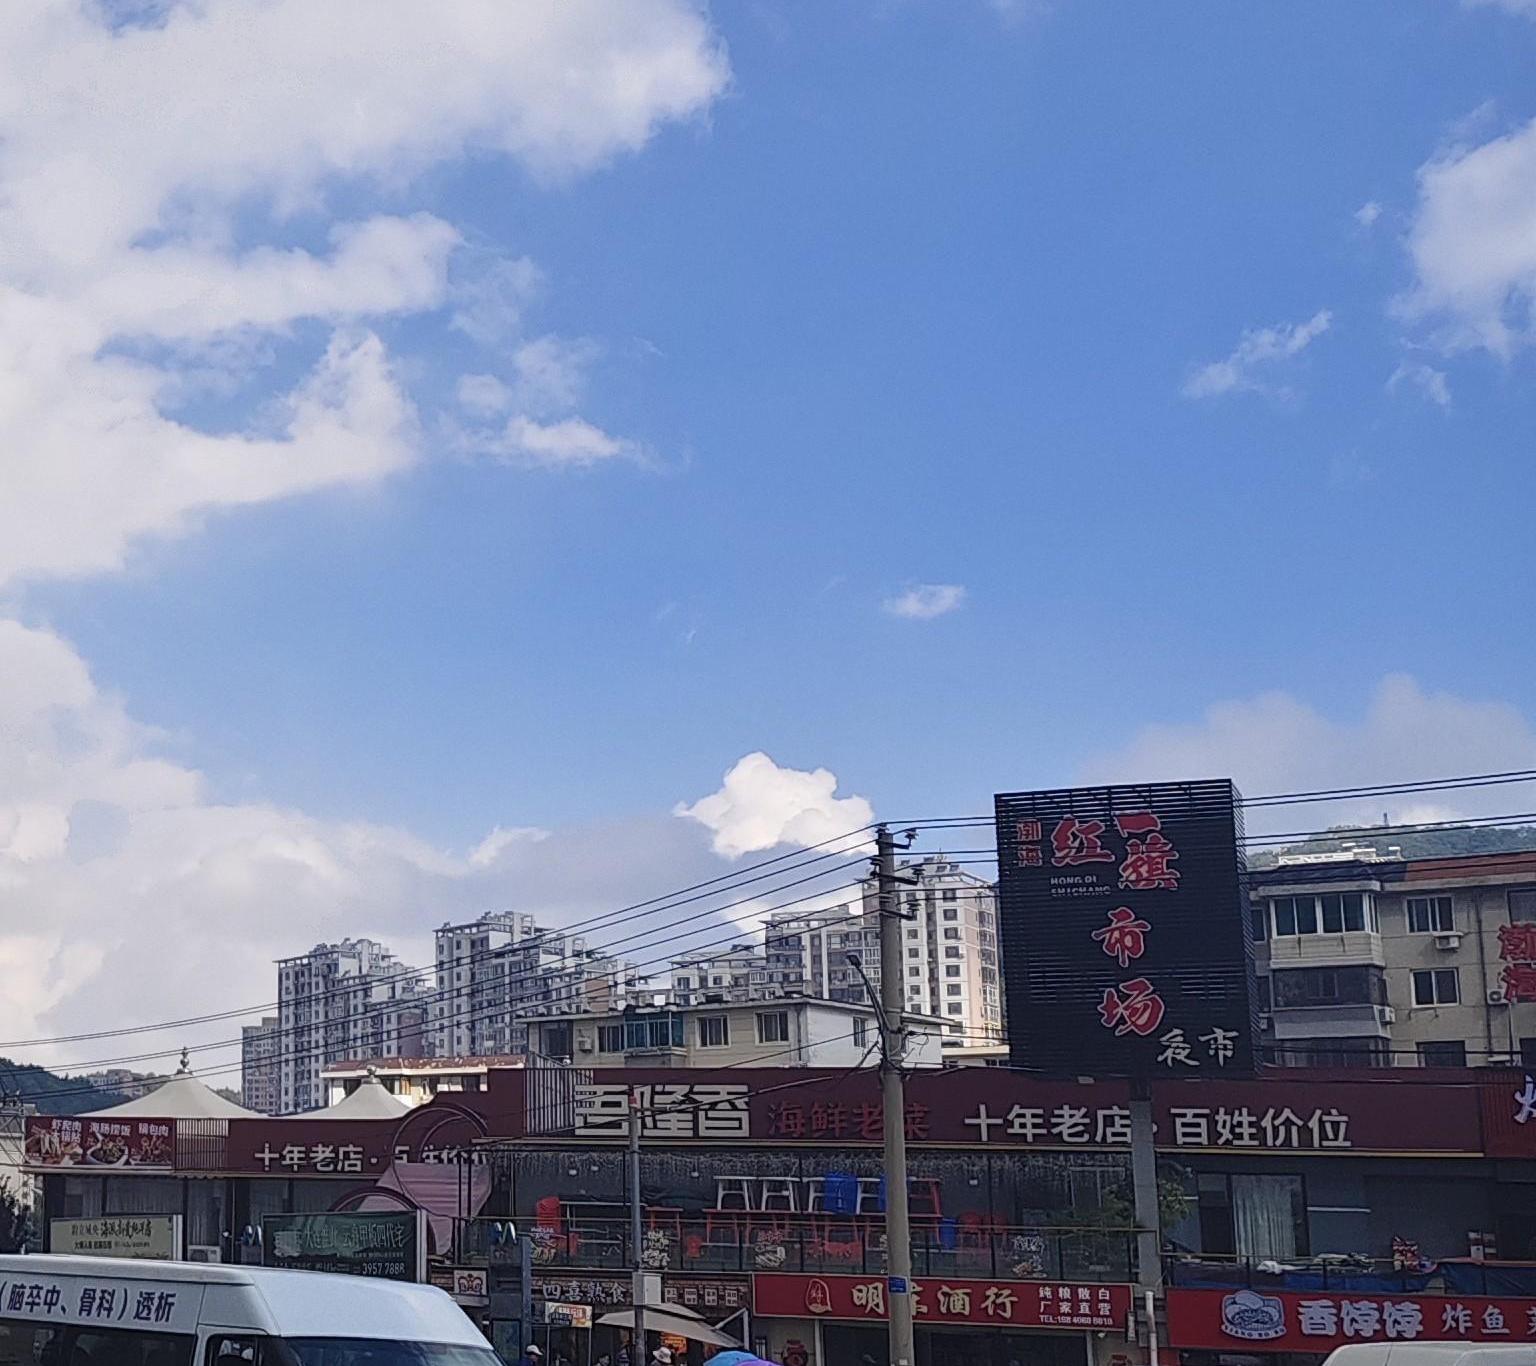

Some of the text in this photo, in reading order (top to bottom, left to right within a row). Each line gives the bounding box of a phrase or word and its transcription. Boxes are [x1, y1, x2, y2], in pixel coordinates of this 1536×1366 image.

[1157, 1027, 1239, 1067] 夜市
[542, 1280, 627, 1303] 四喜熟食
[1040, 1301, 1111, 1315] 厂家直营
[1298, 1299, 1424, 1339] 香饽饽
